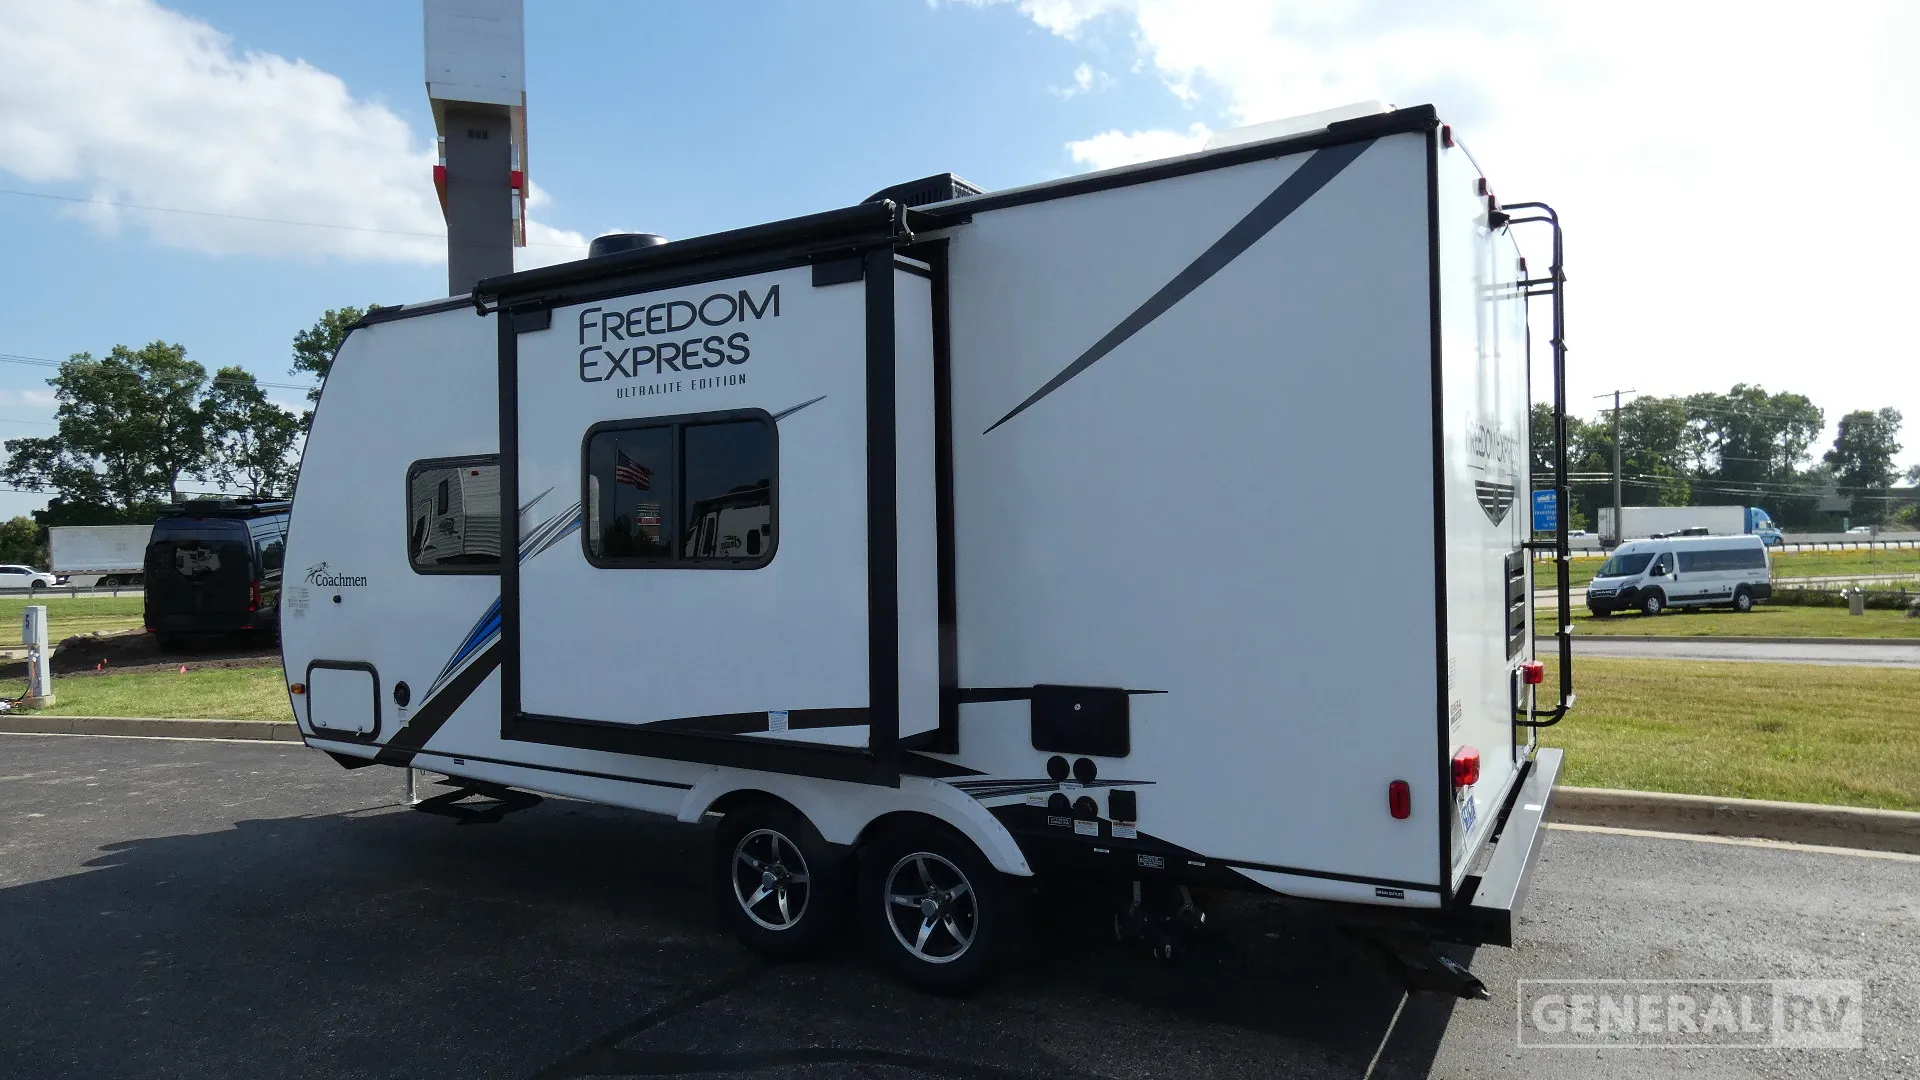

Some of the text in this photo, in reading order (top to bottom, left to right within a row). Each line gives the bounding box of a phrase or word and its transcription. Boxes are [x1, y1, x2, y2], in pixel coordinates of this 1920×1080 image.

[579, 284, 780, 345] FREEDOM
[579, 332, 750, 383] EXPRESS
[616, 373, 746, 399] ULTRALITE EDITION
[315, 573, 367, 587] Coachmen
